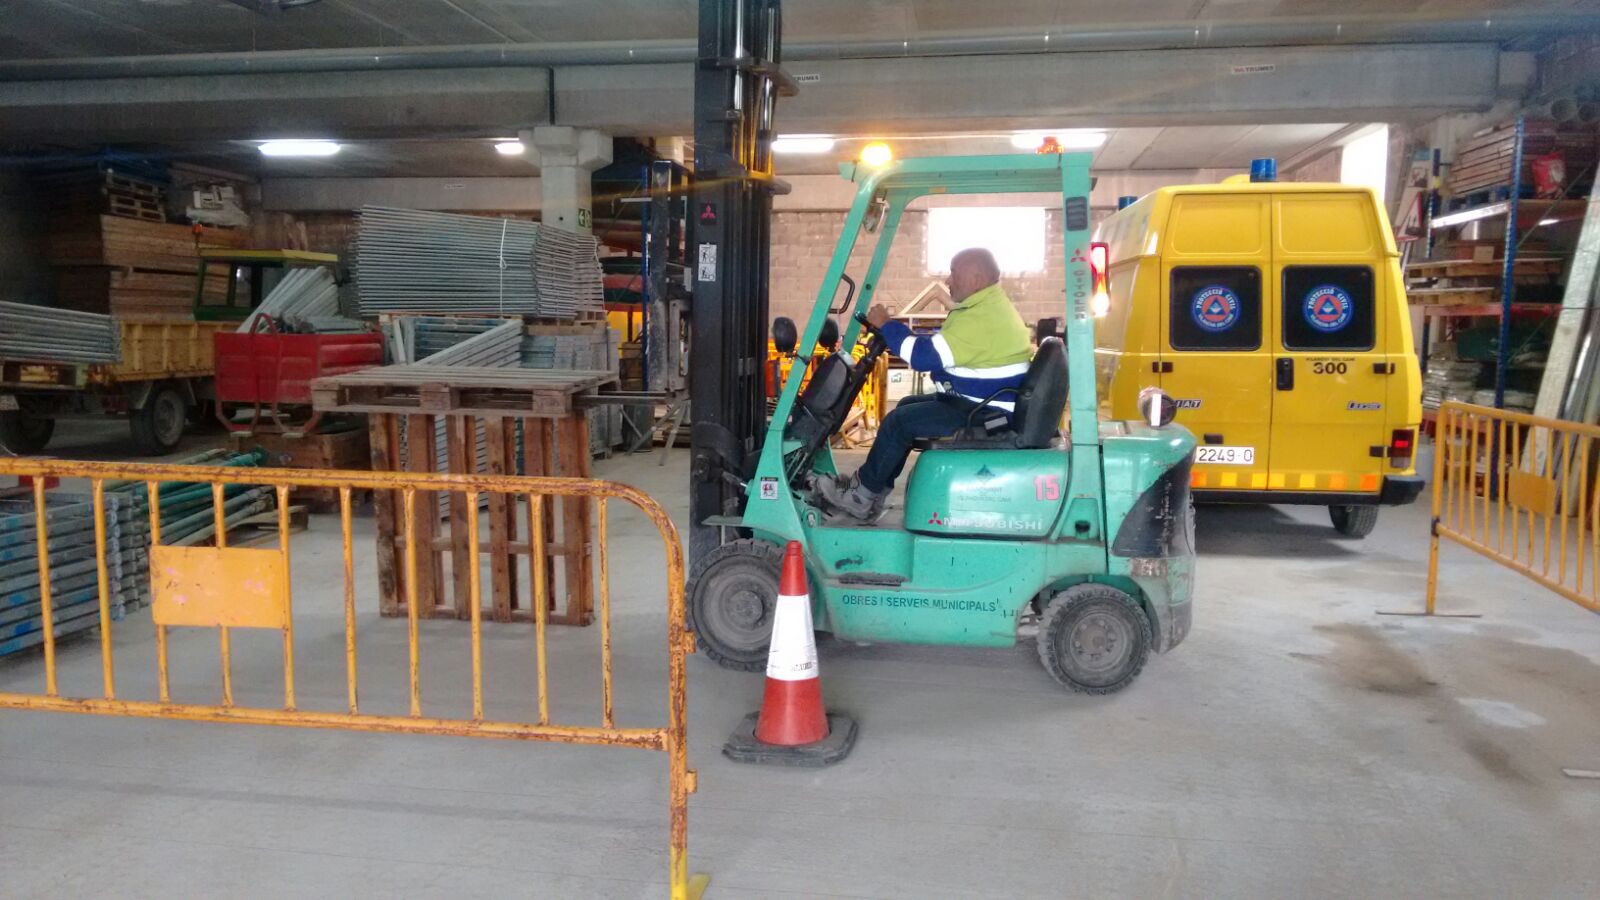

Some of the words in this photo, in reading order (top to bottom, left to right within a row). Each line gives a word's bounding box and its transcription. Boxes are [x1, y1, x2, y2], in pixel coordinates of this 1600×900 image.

[1225, 294, 1236, 309] CIVIL
[1337, 293, 1348, 309] CIVIL
[1313, 362, 1347, 374] 300
[1176, 400, 1200, 408] IAT
[1033, 475, 1059, 501] 15
[842, 594, 878, 606] OBRES
[886, 596, 929, 608] SERVEIS
[933, 599, 996, 612] MUNICIPALS
